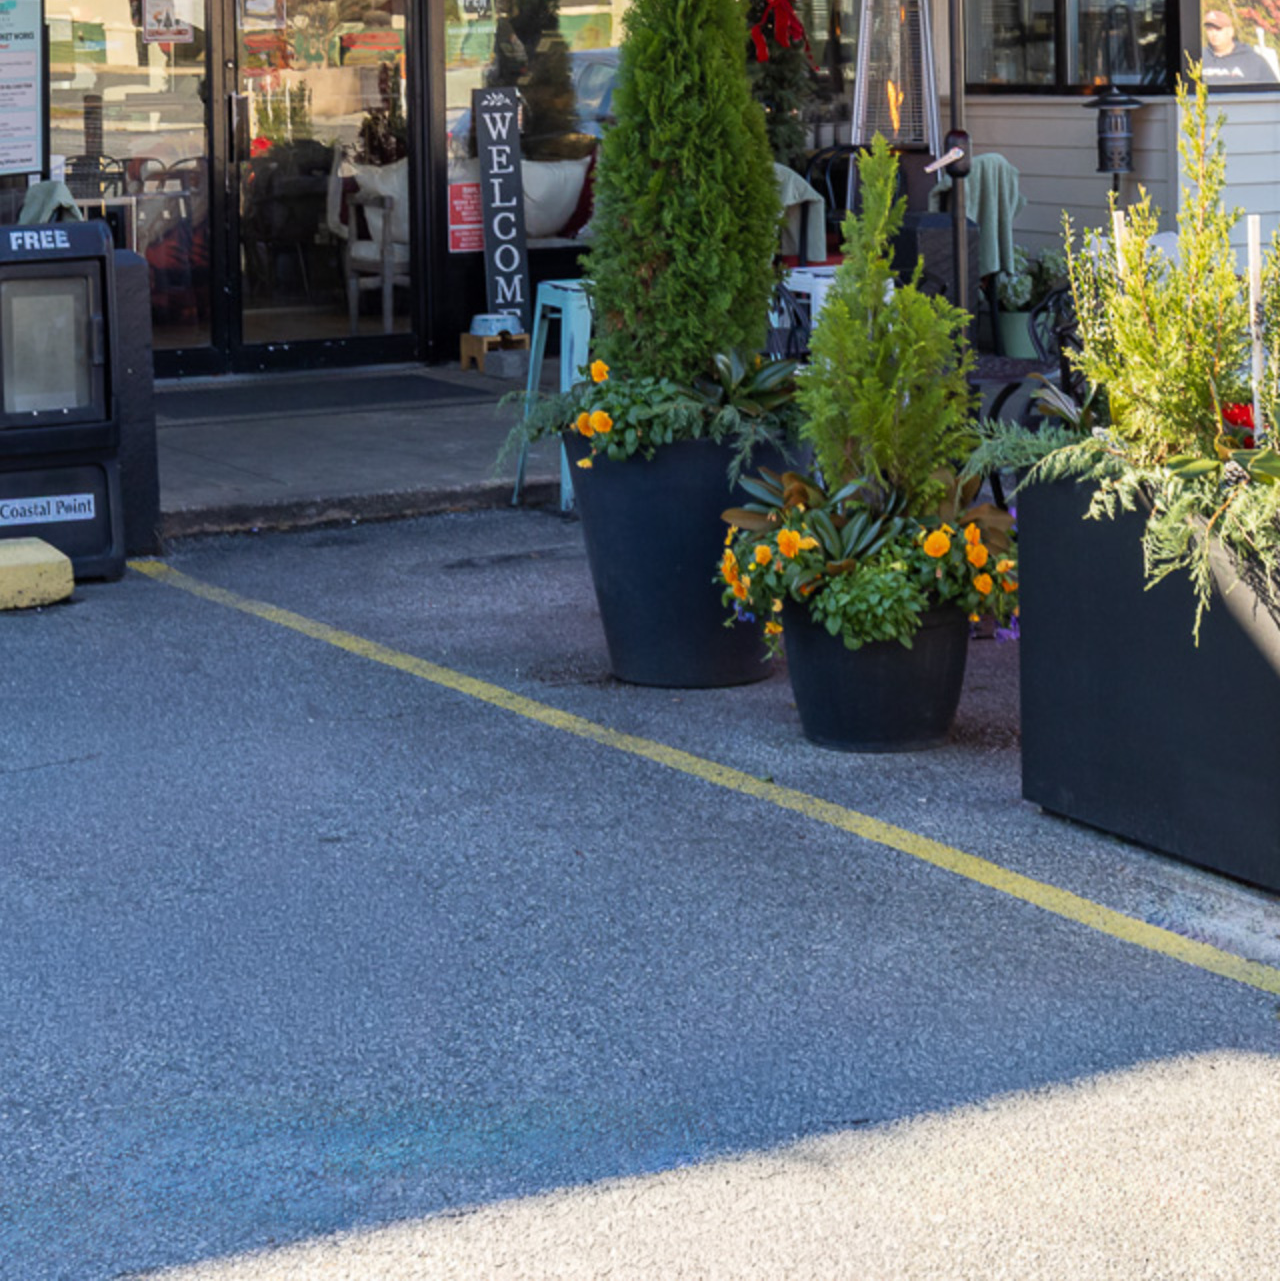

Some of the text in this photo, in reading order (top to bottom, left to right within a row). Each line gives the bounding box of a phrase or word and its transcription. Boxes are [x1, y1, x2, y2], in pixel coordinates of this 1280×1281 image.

[482, 112, 524, 317] WELCOM
[10, 229, 70, 250] FREE
[0, 498, 93, 520] Coastal Point
